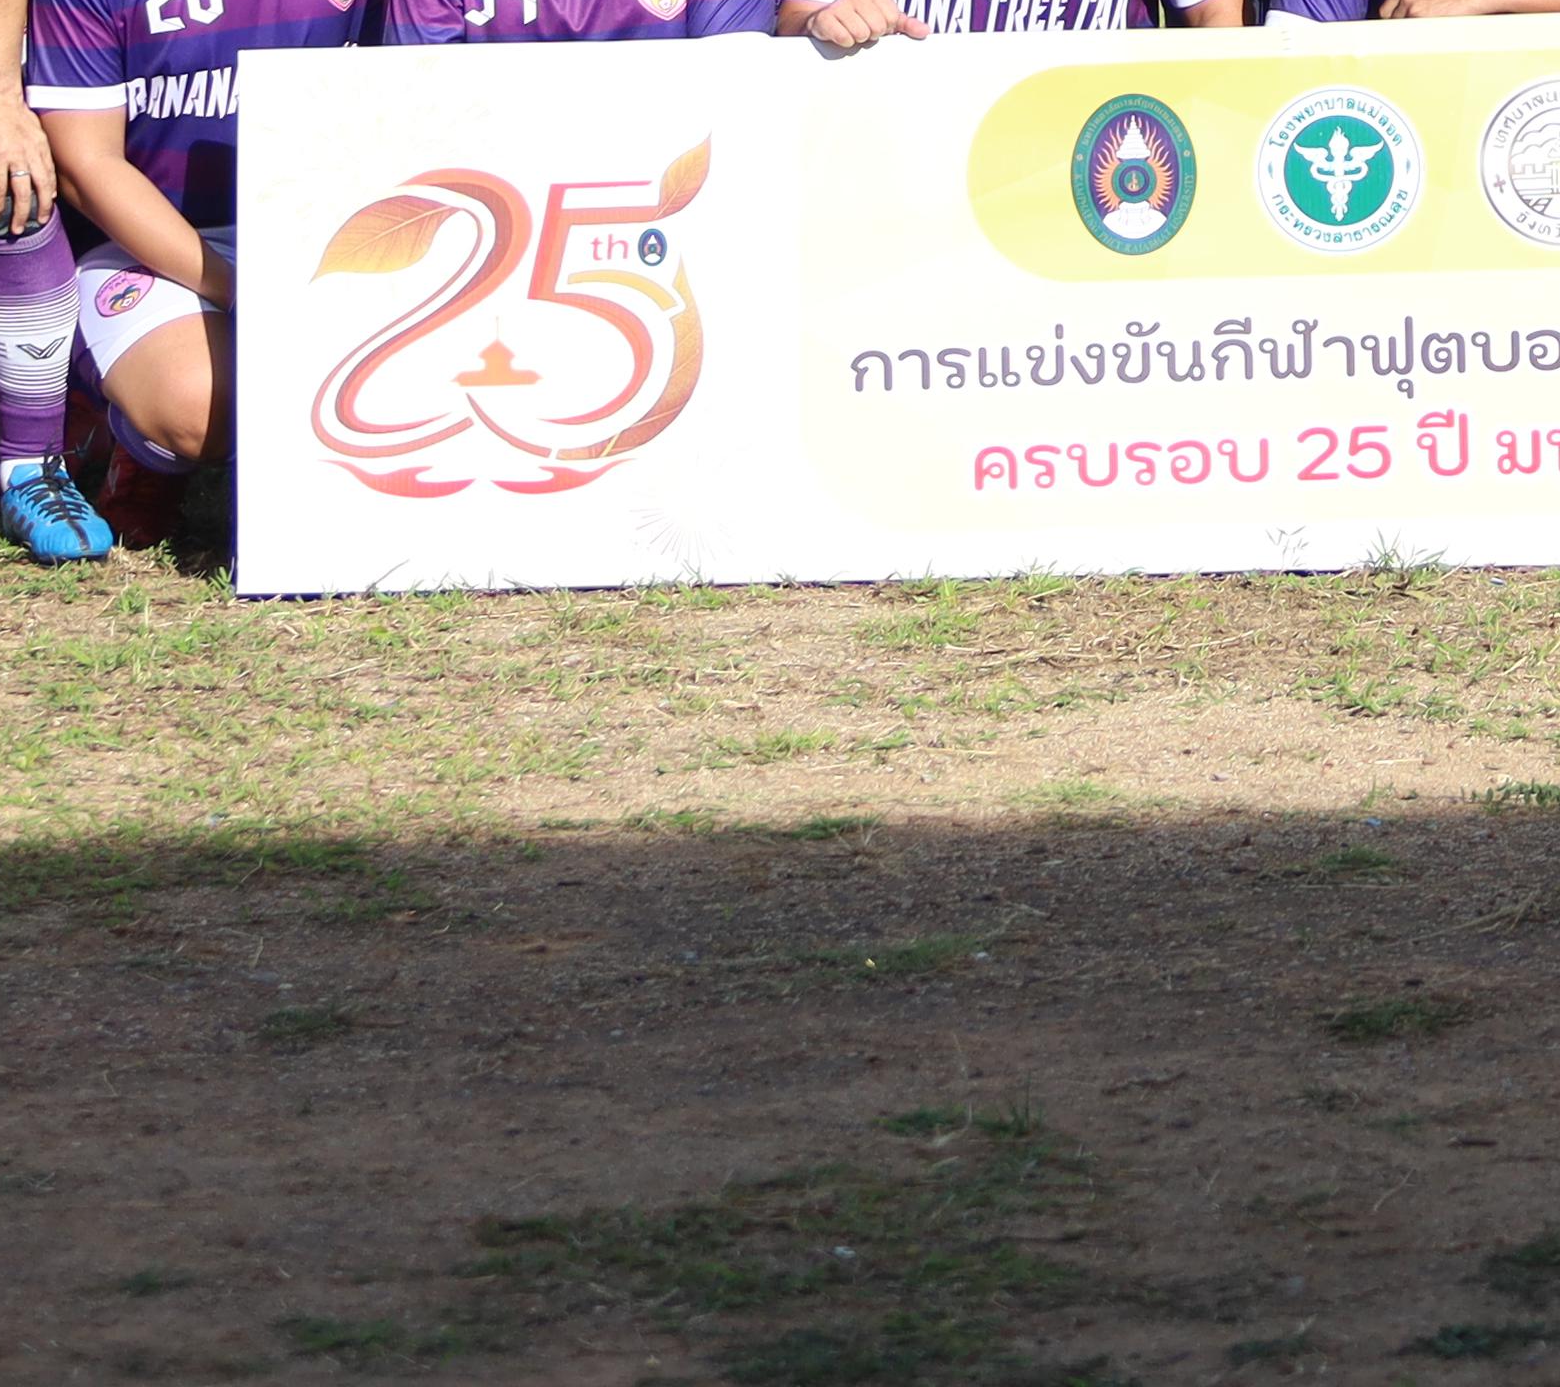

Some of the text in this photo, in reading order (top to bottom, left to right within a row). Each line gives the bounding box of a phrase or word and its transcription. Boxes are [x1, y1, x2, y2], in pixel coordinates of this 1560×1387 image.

[589, 232, 630, 262] th
[308, 167, 704, 461] 25
[972, 433, 1271, 493] ครบรอบ
[1296, 425, 1393, 482] 25
[1416, 409, 1470, 478] ปี
